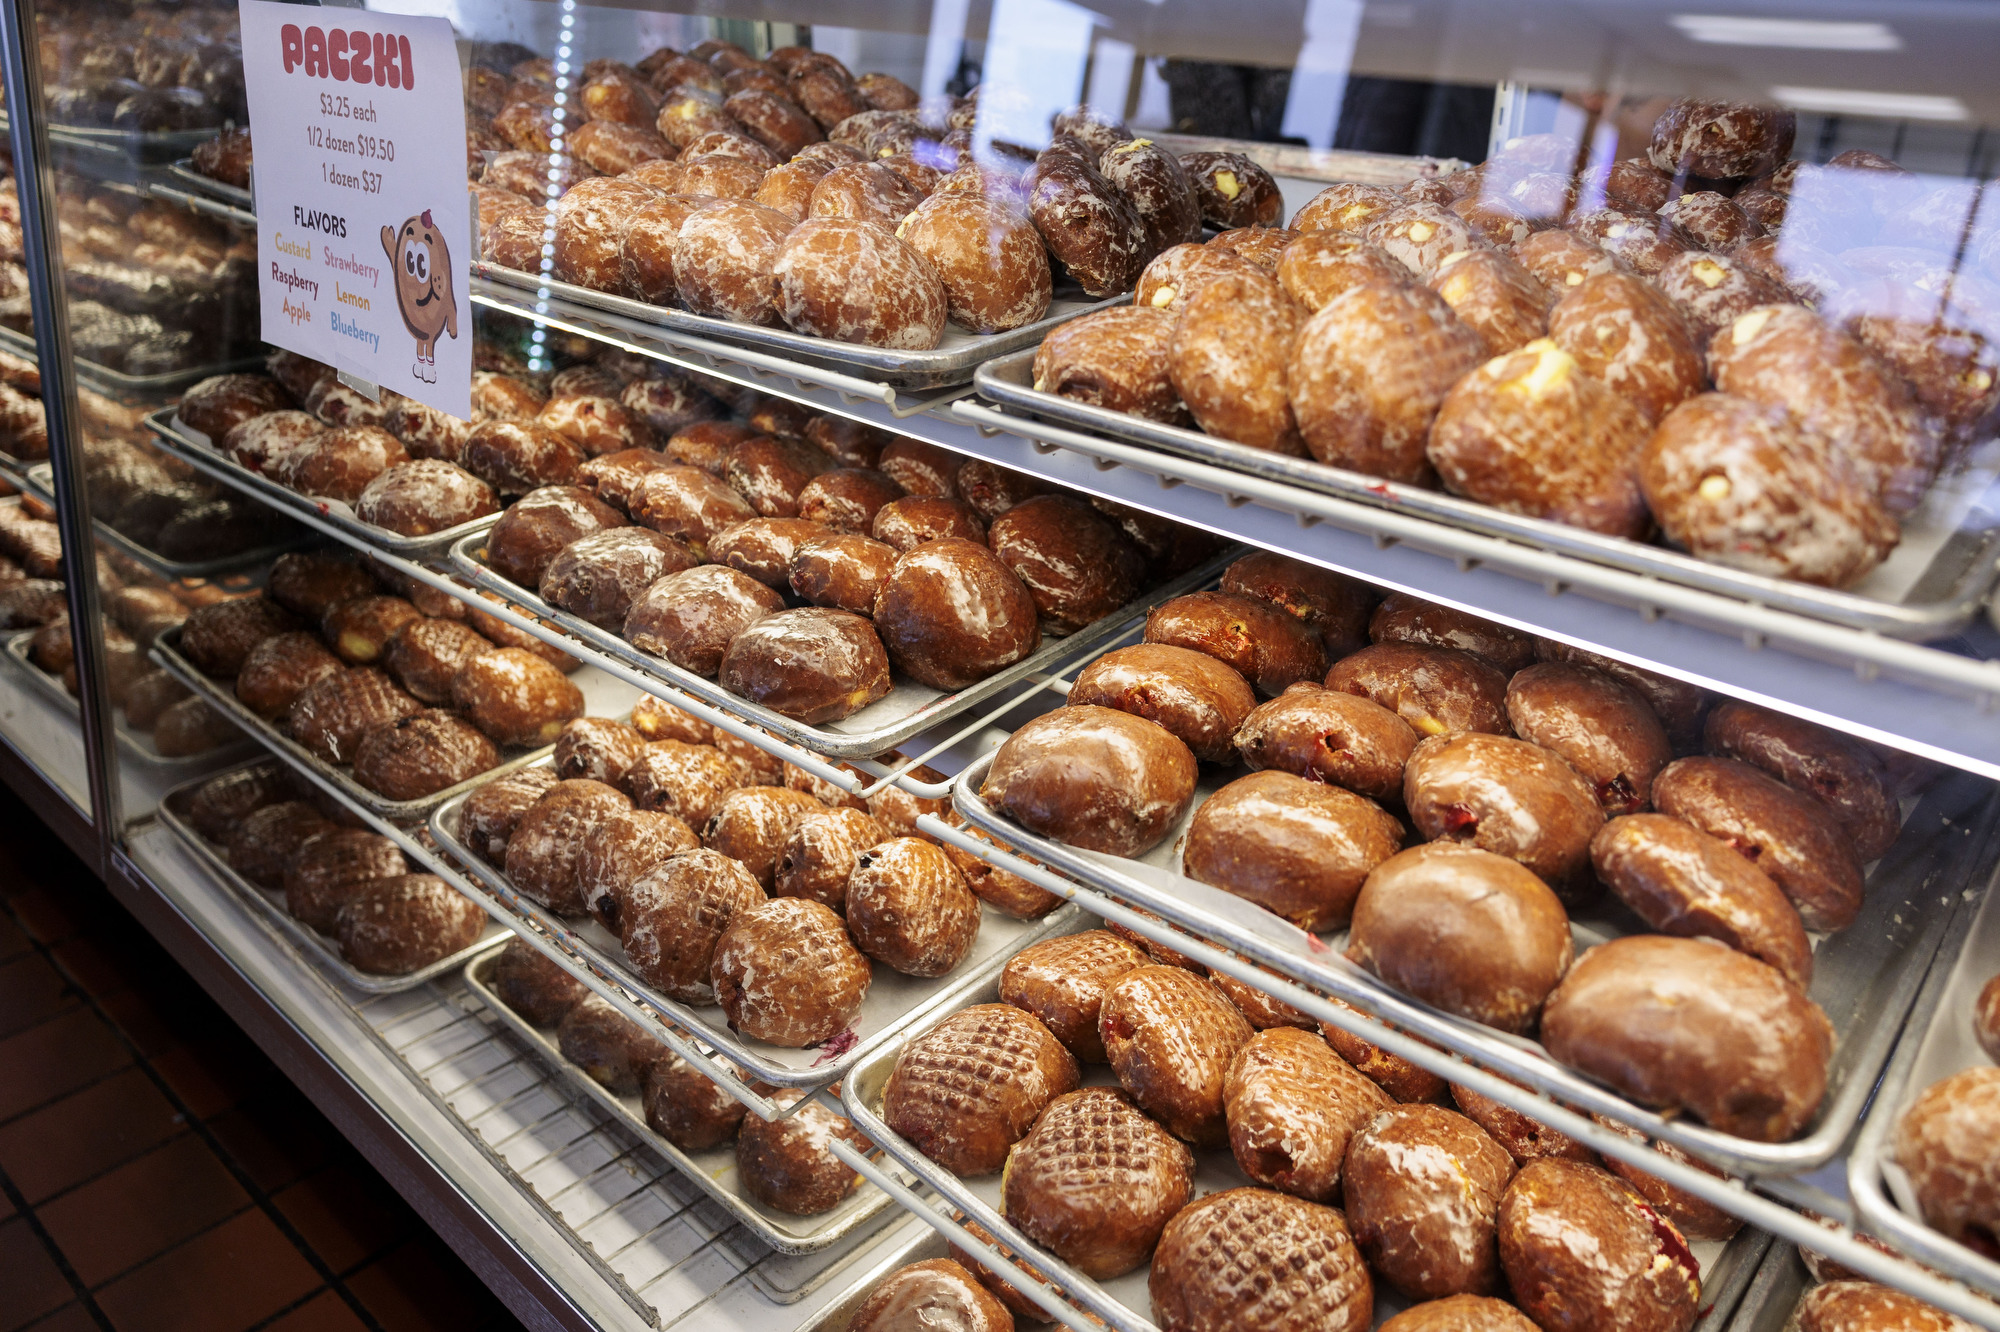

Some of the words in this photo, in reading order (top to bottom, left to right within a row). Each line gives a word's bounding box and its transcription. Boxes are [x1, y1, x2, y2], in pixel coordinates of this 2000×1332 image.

[281, 24, 415, 91] PACZKI
[320, 93, 350, 118] $3.25
[353, 100, 377, 123] each
[307, 126, 323, 148] 1/2
[325, 129, 354, 154] dozen
[358, 133, 395, 162] $19.50
[322, 163, 327, 183] 1
[329, 165, 359, 189] dozen
[362, 171, 382, 194] $37
[294, 206, 347, 238] FLAVORS
[275, 232, 311, 261] Custard
[271, 262, 319, 300] Raspberry
[324, 246, 380, 288] Strawberry
[282, 296, 311, 326] Apple
[336, 281, 370, 310] Lemon
[331, 312, 380, 353] Blueberry
